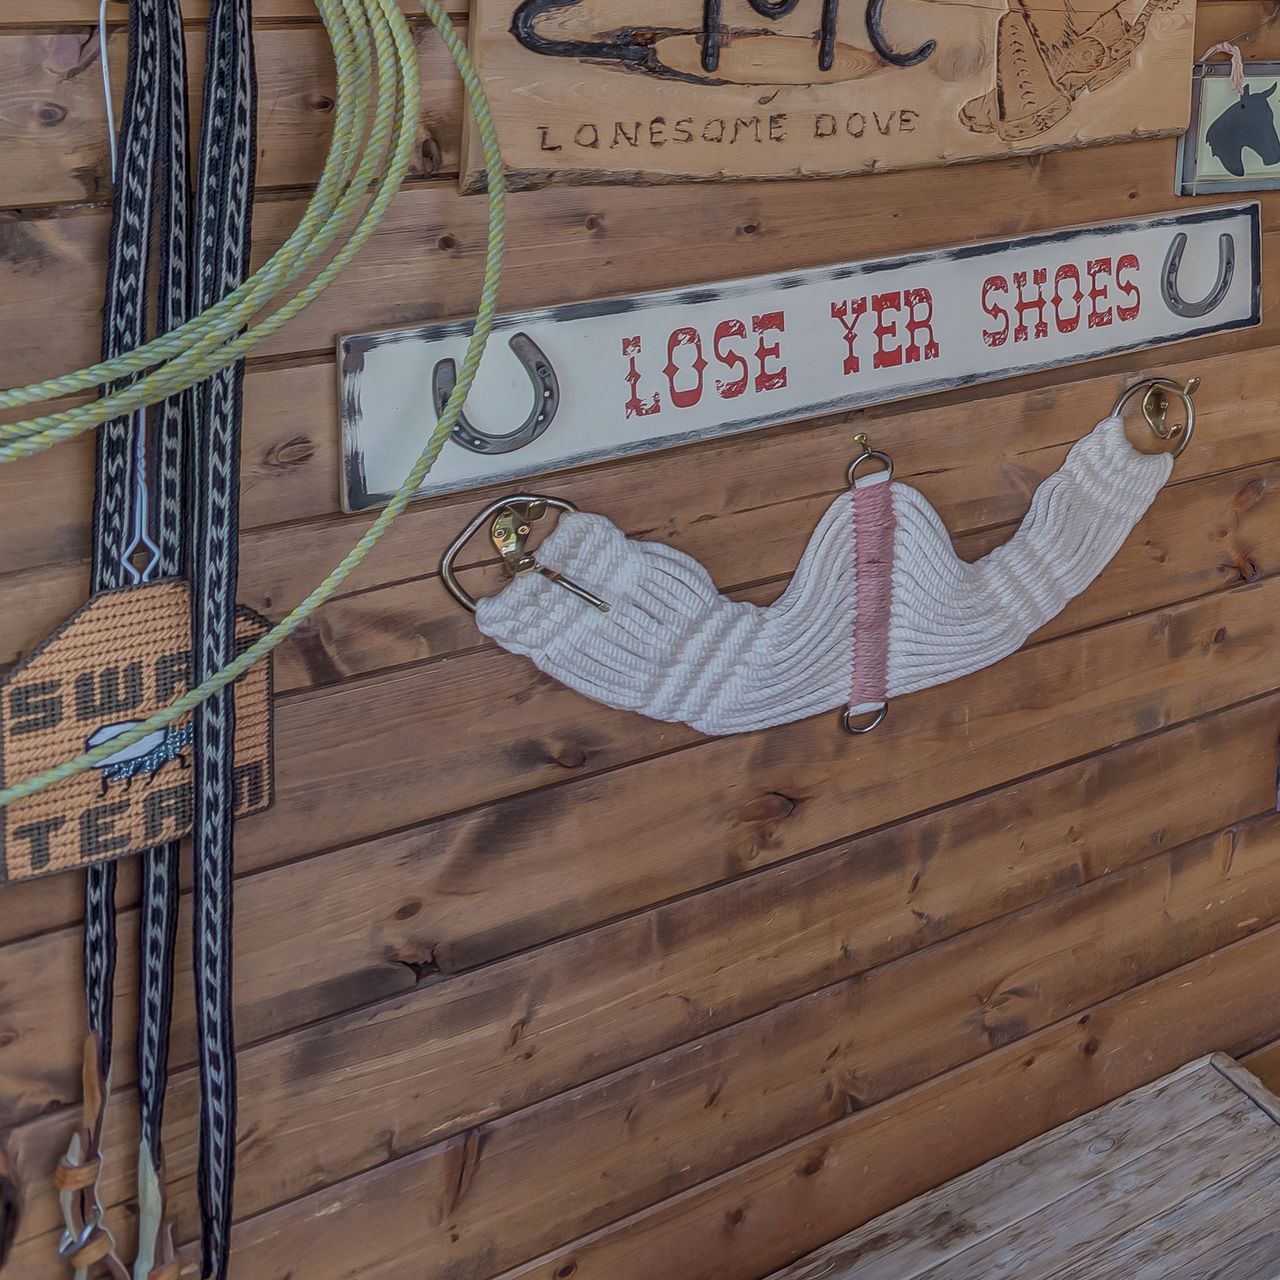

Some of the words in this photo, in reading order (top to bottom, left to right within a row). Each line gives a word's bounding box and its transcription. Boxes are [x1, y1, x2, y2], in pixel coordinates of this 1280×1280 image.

[537, 114, 788, 152] LONESOME
[813, 109, 921, 139] DOVE
[621, 310, 788, 420] LOSE
[830, 287, 940, 375] YER
[980, 253, 1143, 348] SHOES
